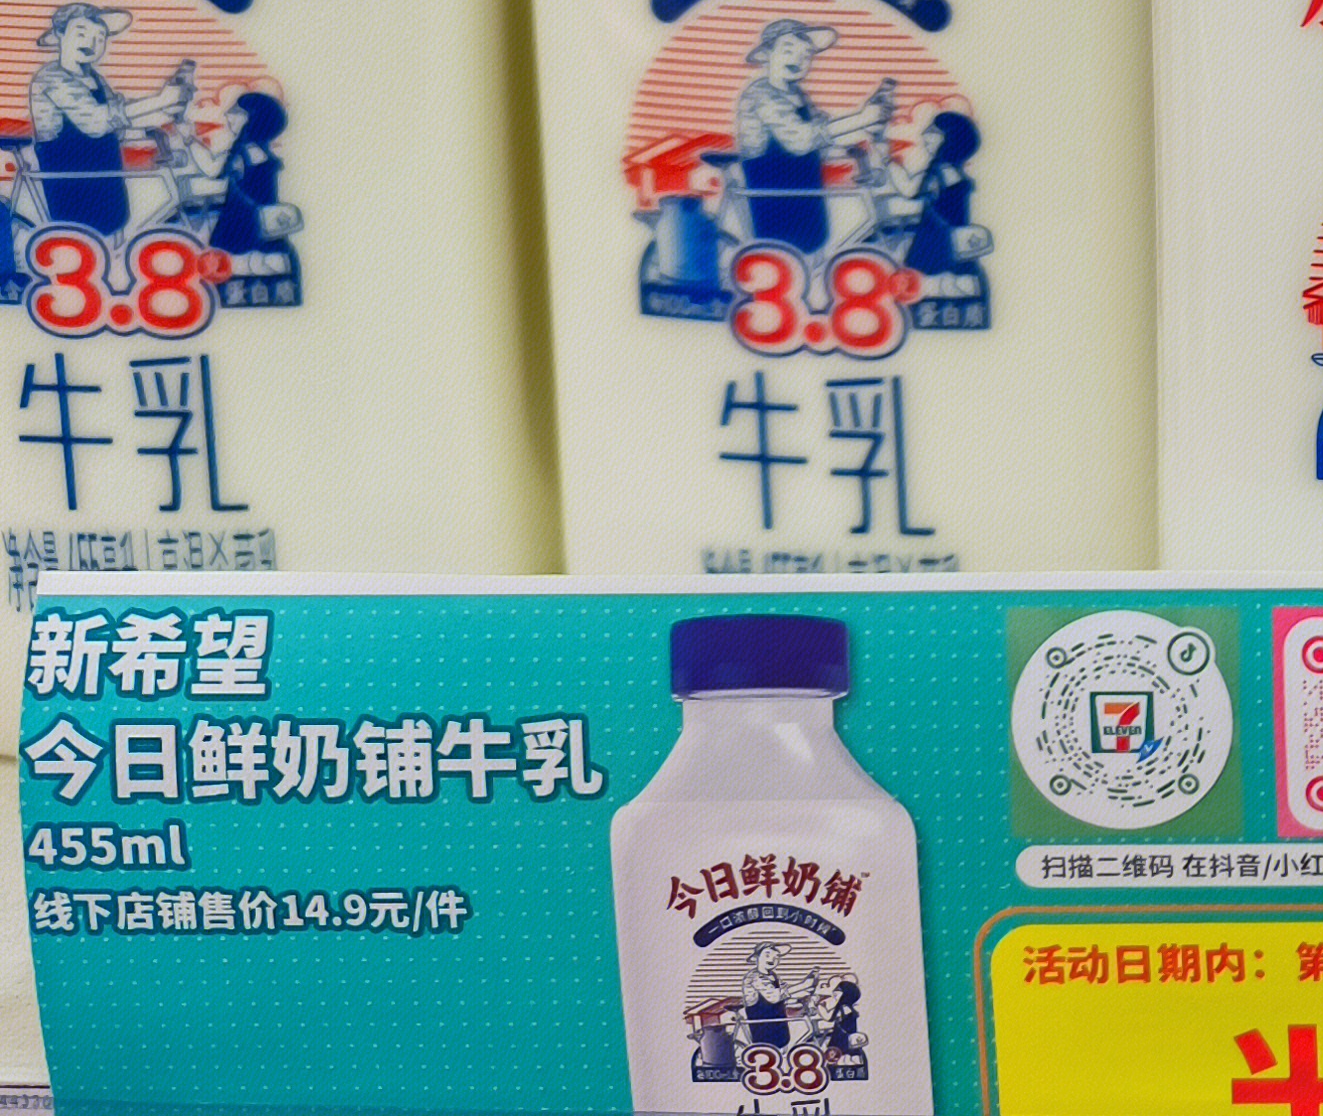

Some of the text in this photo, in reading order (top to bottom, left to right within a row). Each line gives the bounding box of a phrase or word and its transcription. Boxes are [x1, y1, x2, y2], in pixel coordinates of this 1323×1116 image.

[35, 236, 204, 330] 3.8
[734, 252, 893, 350] 3.8
[19, 353, 249, 511] 牛乳
[719, 372, 935, 537] 牛乳
[27, 613, 269, 695] 新希望
[25, 719, 604, 800] 今日鲜奶铺牛乳
[28, 825, 185, 866] 455ml
[1041, 854, 1174, 880] 扫描二维码
[33, 890, 468, 933] 线下店铺售价14.9元/件
[747, 1049, 824, 1091] 3.8
